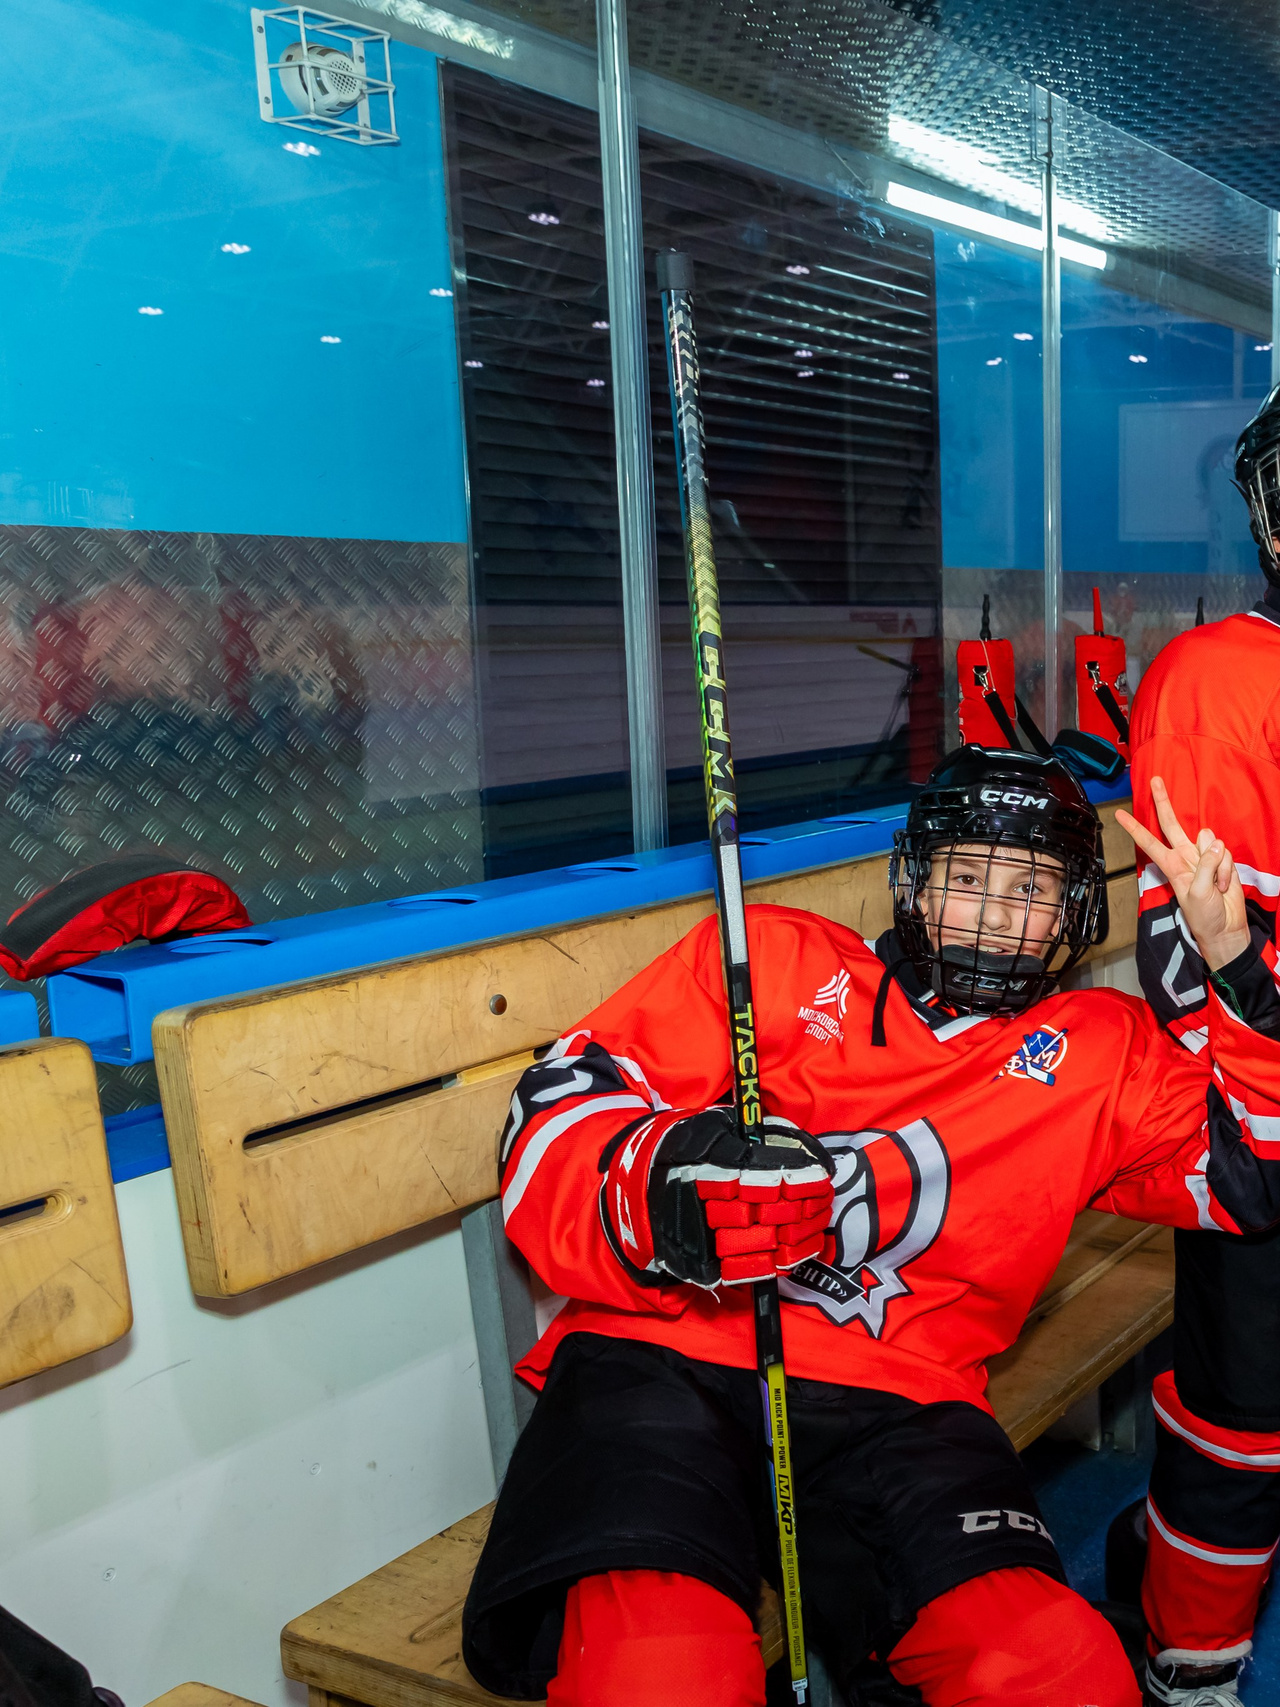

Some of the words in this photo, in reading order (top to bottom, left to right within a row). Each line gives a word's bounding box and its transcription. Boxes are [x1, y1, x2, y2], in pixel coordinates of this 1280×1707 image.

[980, 789, 1050, 810] CCM
[952, 970, 1028, 992] CCM
[805, 1022, 833, 1046] СПОРТ
[734, 1002, 762, 1126] TACKS
[1004, 1050, 1057, 1071] ФМ
[777, 1419, 785, 1439] POINT
[778, 1445, 787, 1470] POWER
